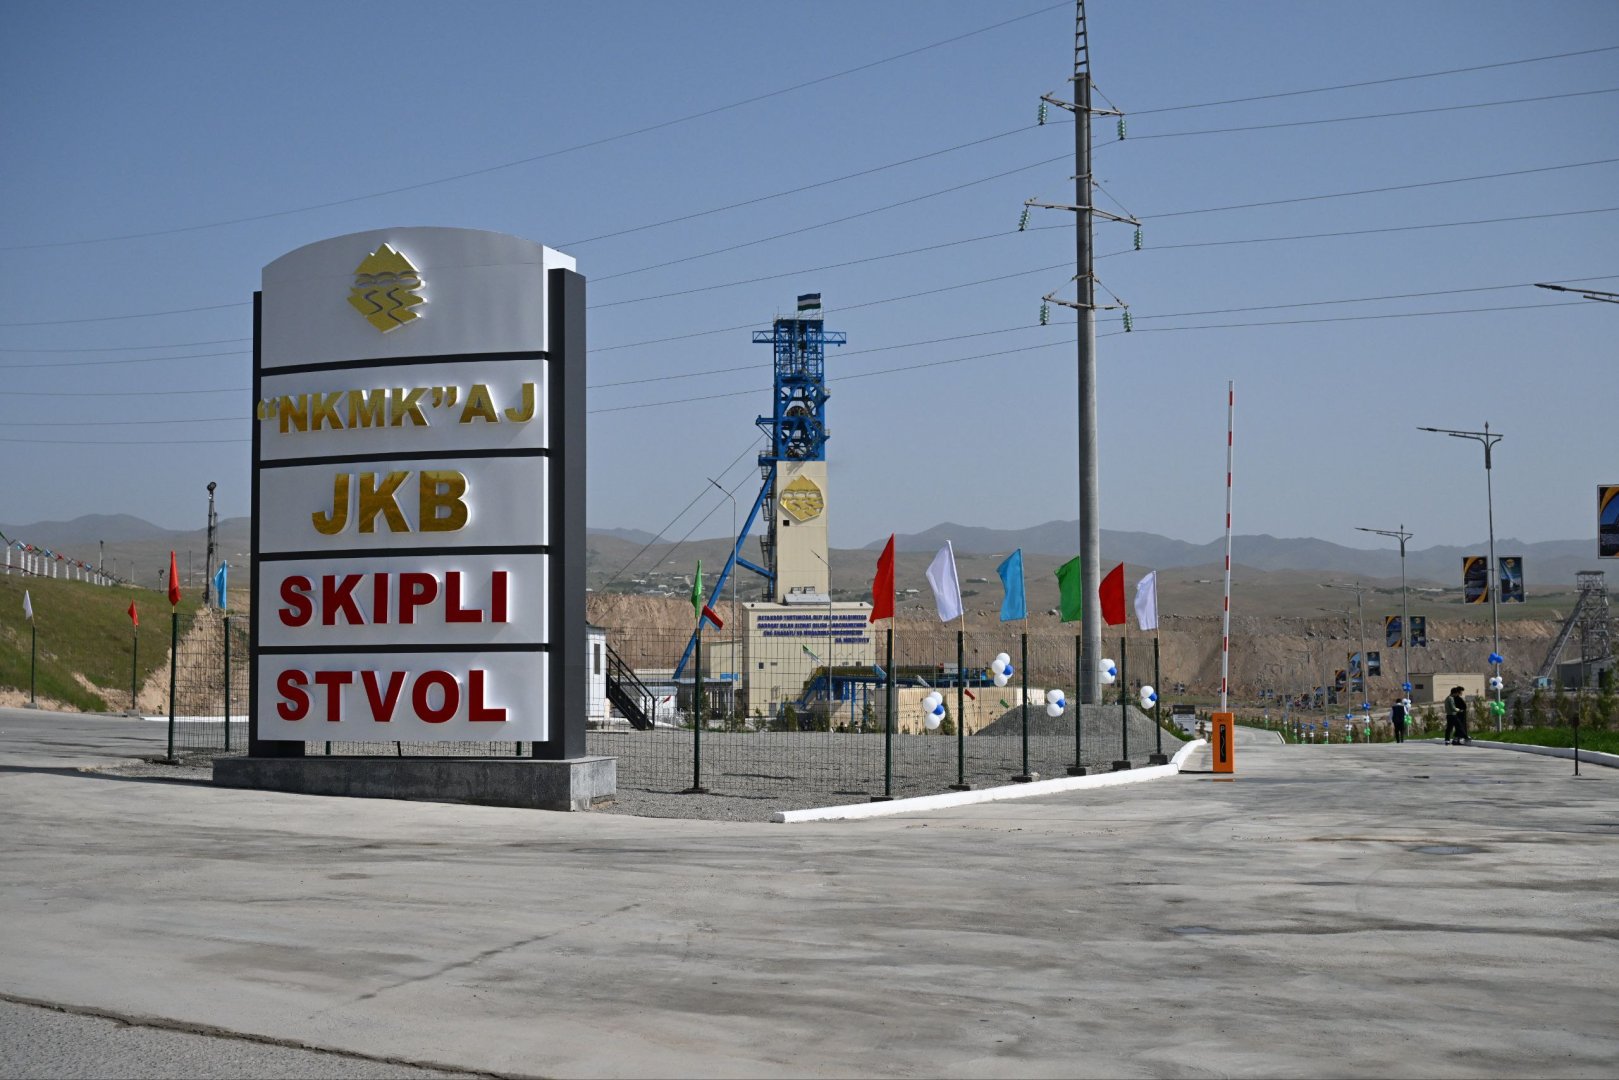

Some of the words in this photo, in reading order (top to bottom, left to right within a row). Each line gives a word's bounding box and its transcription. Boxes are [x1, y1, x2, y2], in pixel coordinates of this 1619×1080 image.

[312, 470, 469, 535] JKB
[279, 571, 508, 627] SKIPLI
[277, 669, 507, 723] STVOL
